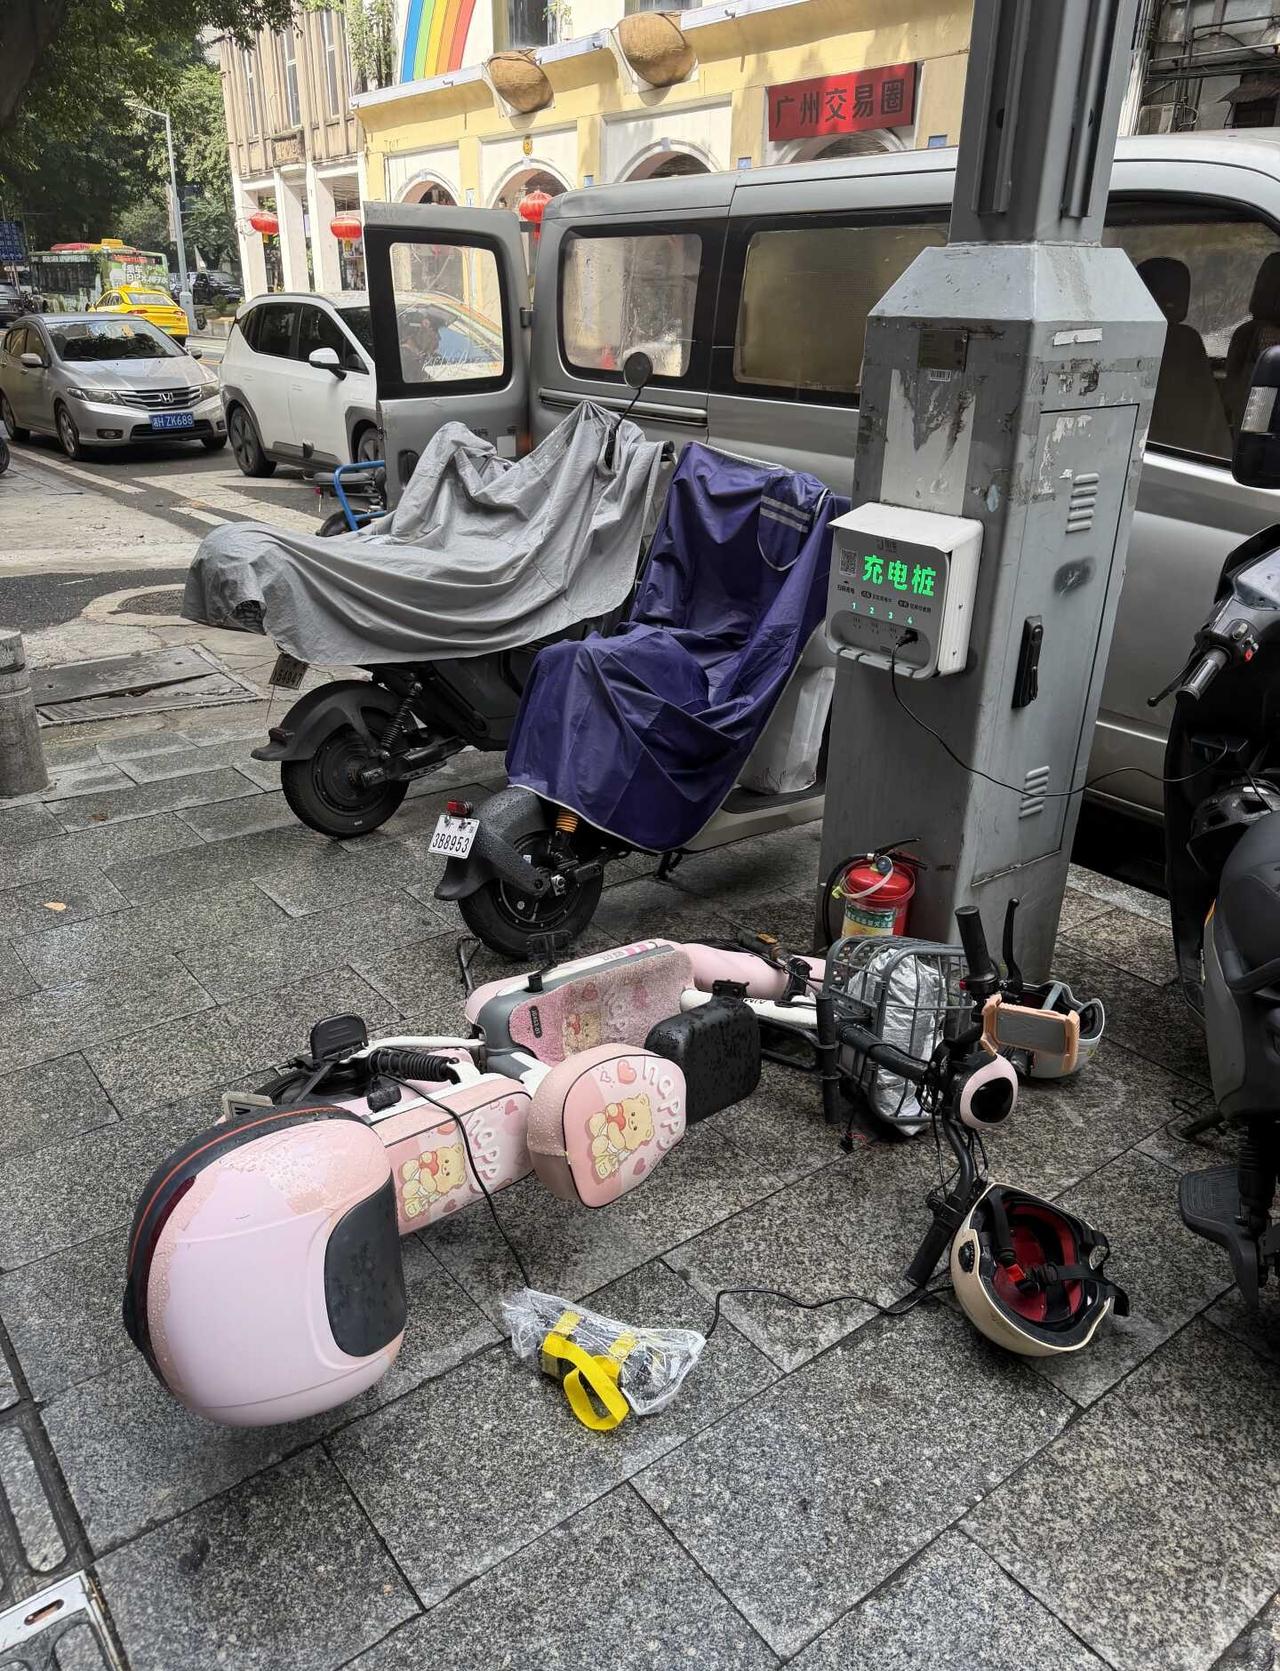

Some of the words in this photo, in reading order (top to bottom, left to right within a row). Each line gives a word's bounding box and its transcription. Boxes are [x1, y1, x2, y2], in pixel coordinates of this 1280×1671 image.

[776, 78, 905, 128] 广州交易圈
[862, 554, 937, 597] 充电桩
[432, 832, 470, 853] 3B8953
